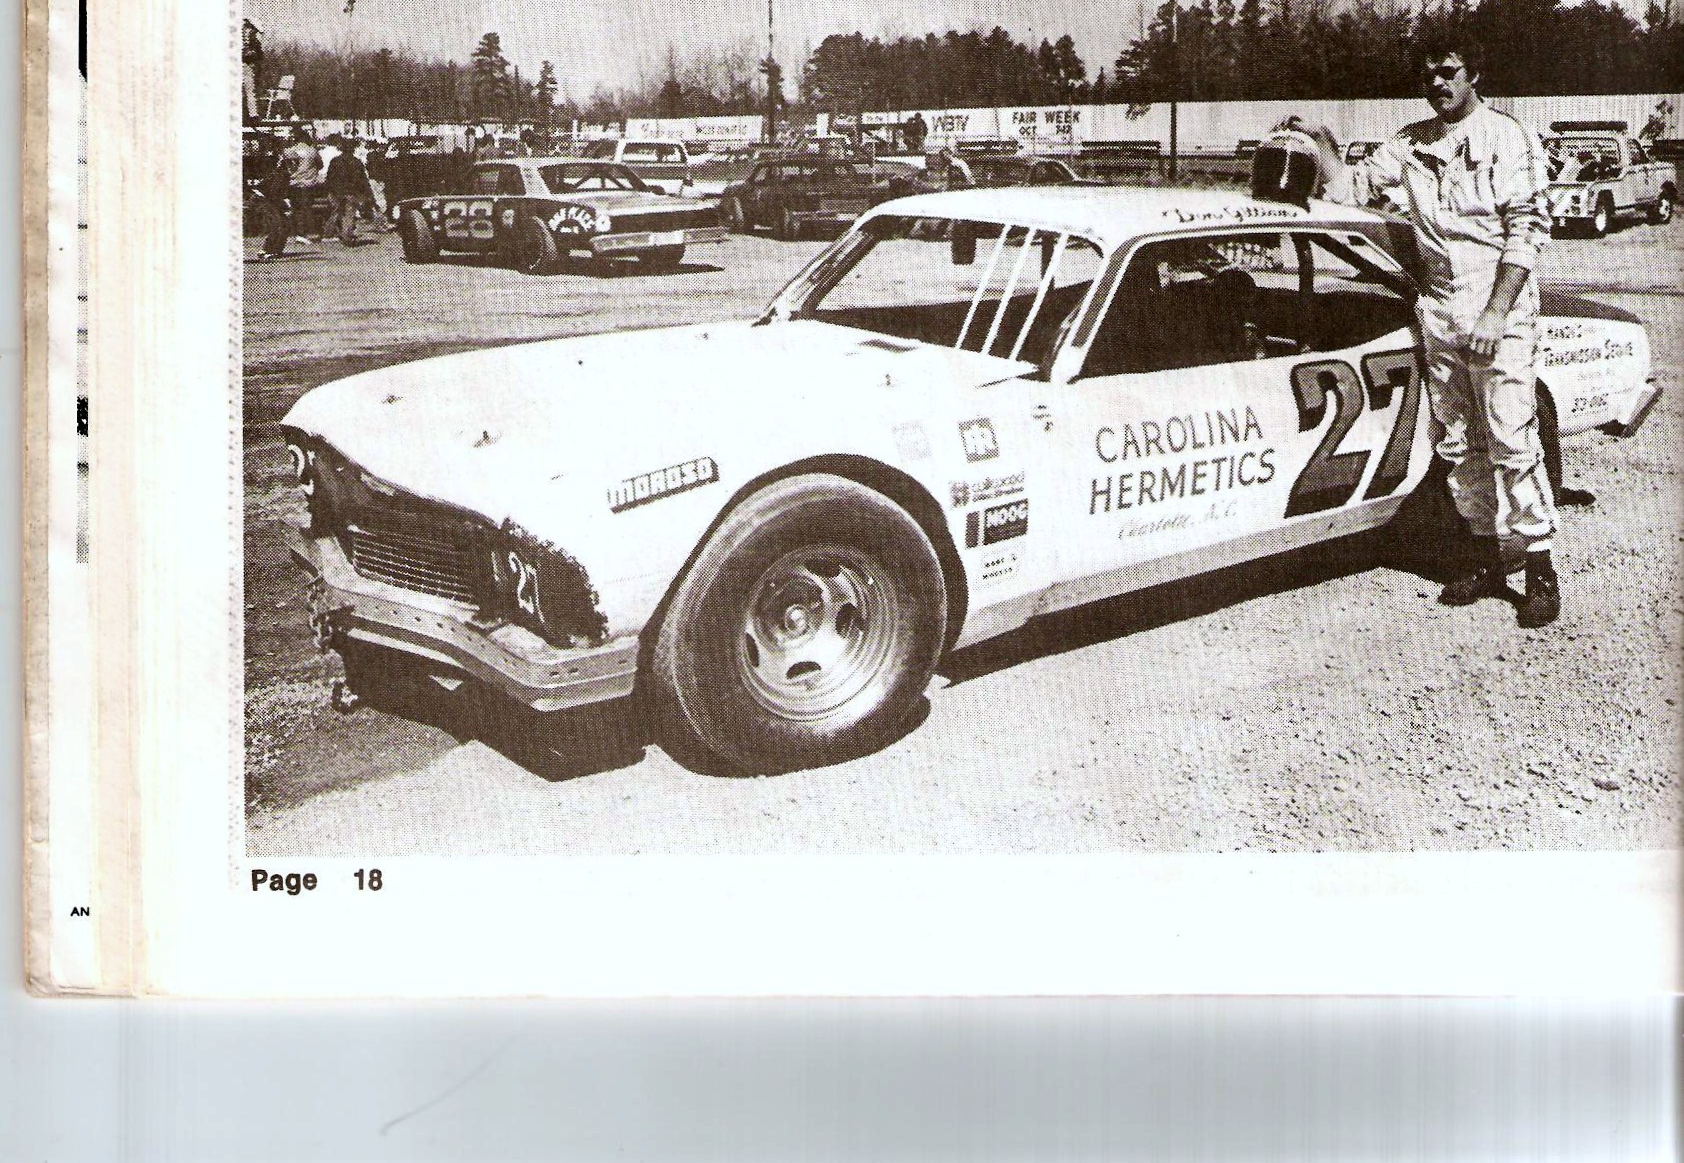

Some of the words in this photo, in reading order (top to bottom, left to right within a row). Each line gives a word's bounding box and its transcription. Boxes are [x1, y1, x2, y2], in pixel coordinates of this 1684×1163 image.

[1012, 111, 1037, 125] FAIR
[1045, 110, 1081, 124] WEEK
[1094, 404, 1264, 464] CAROLINA
[1284, 346, 1422, 519] 27
[1088, 447, 1277, 517] HERMETICS
[251, 869, 318, 896] Page
[353, 868, 383, 892] 18
[70, 906, 90, 917] AN
